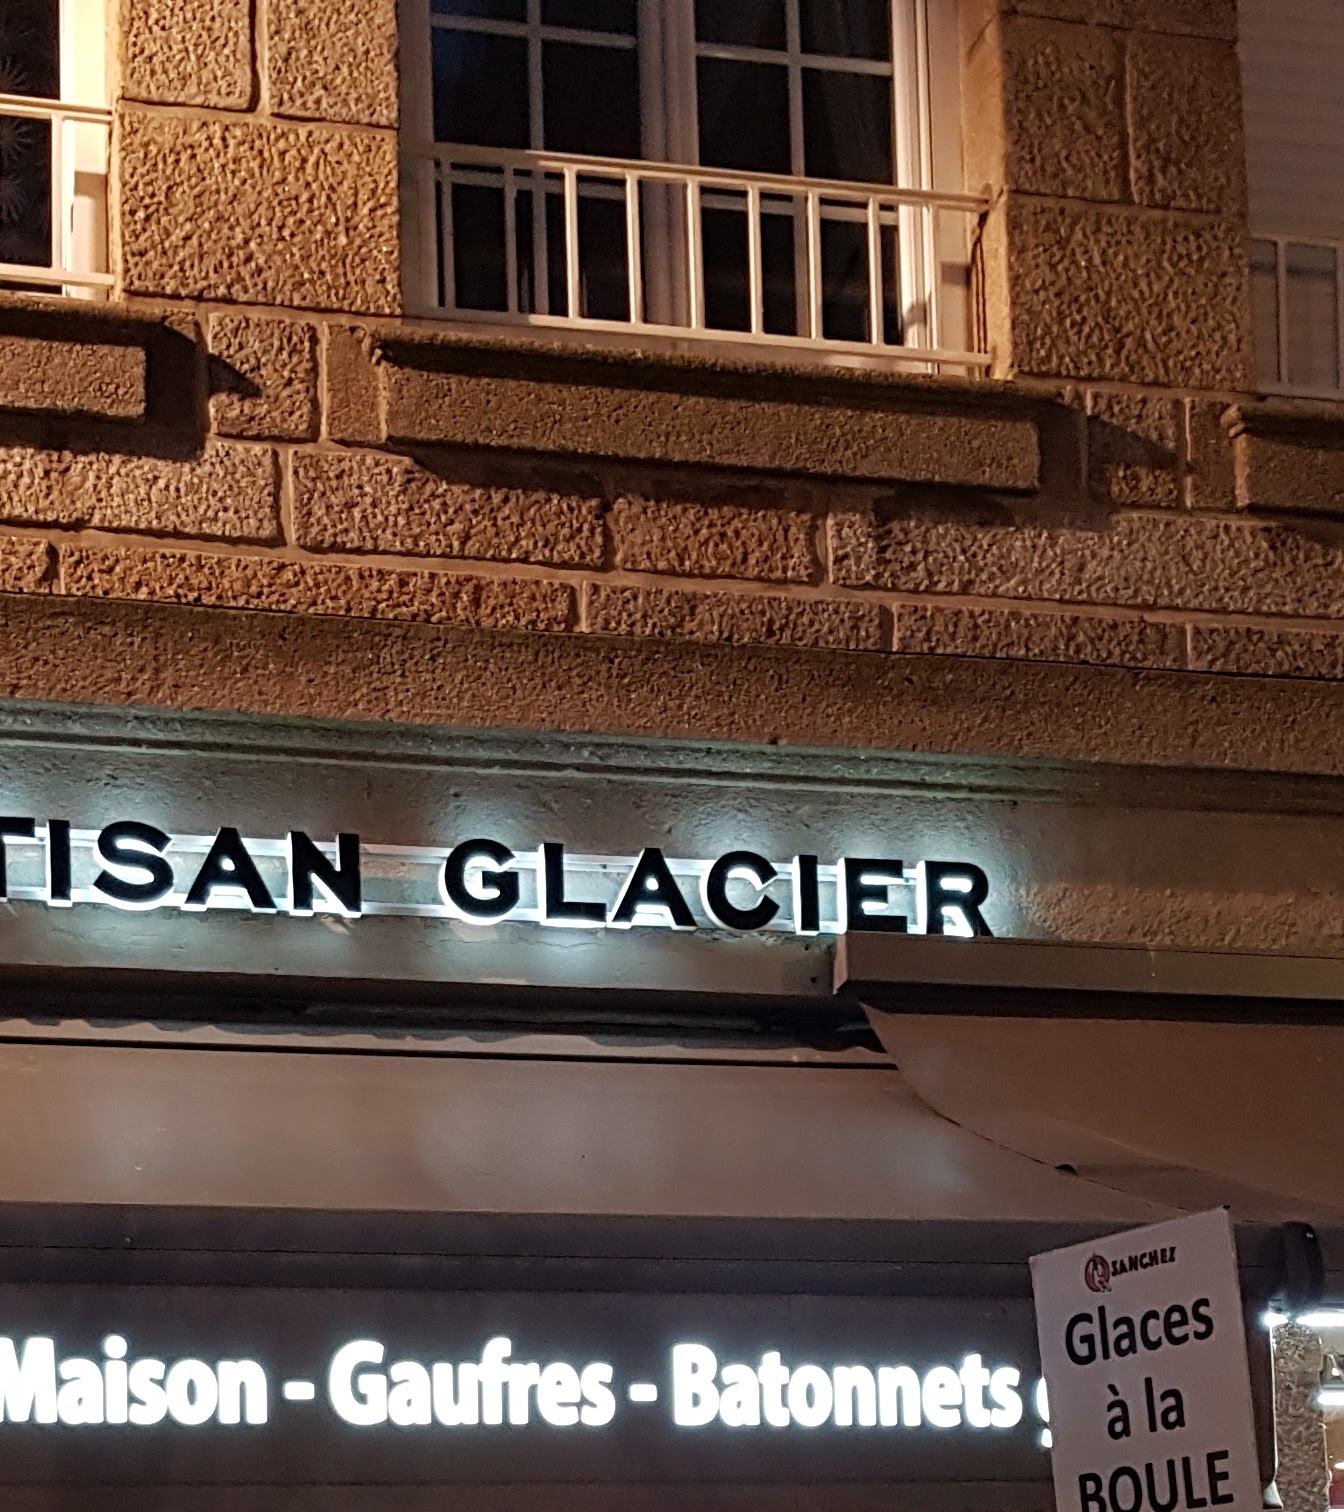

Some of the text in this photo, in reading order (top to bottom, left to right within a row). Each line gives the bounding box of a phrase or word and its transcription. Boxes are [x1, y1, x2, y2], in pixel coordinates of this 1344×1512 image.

[441, 838, 994, 937] GLACIER
[1111, 1245, 1177, 1276] SANCHEZ
[1064, 1298, 1214, 1365] Glaces
[329, 1338, 615, 1426] Gaufres
[674, 1345, 1022, 1428] Batonnets
[1107, 1383, 1130, 1440] à
[1144, 1377, 1185, 1434] la
